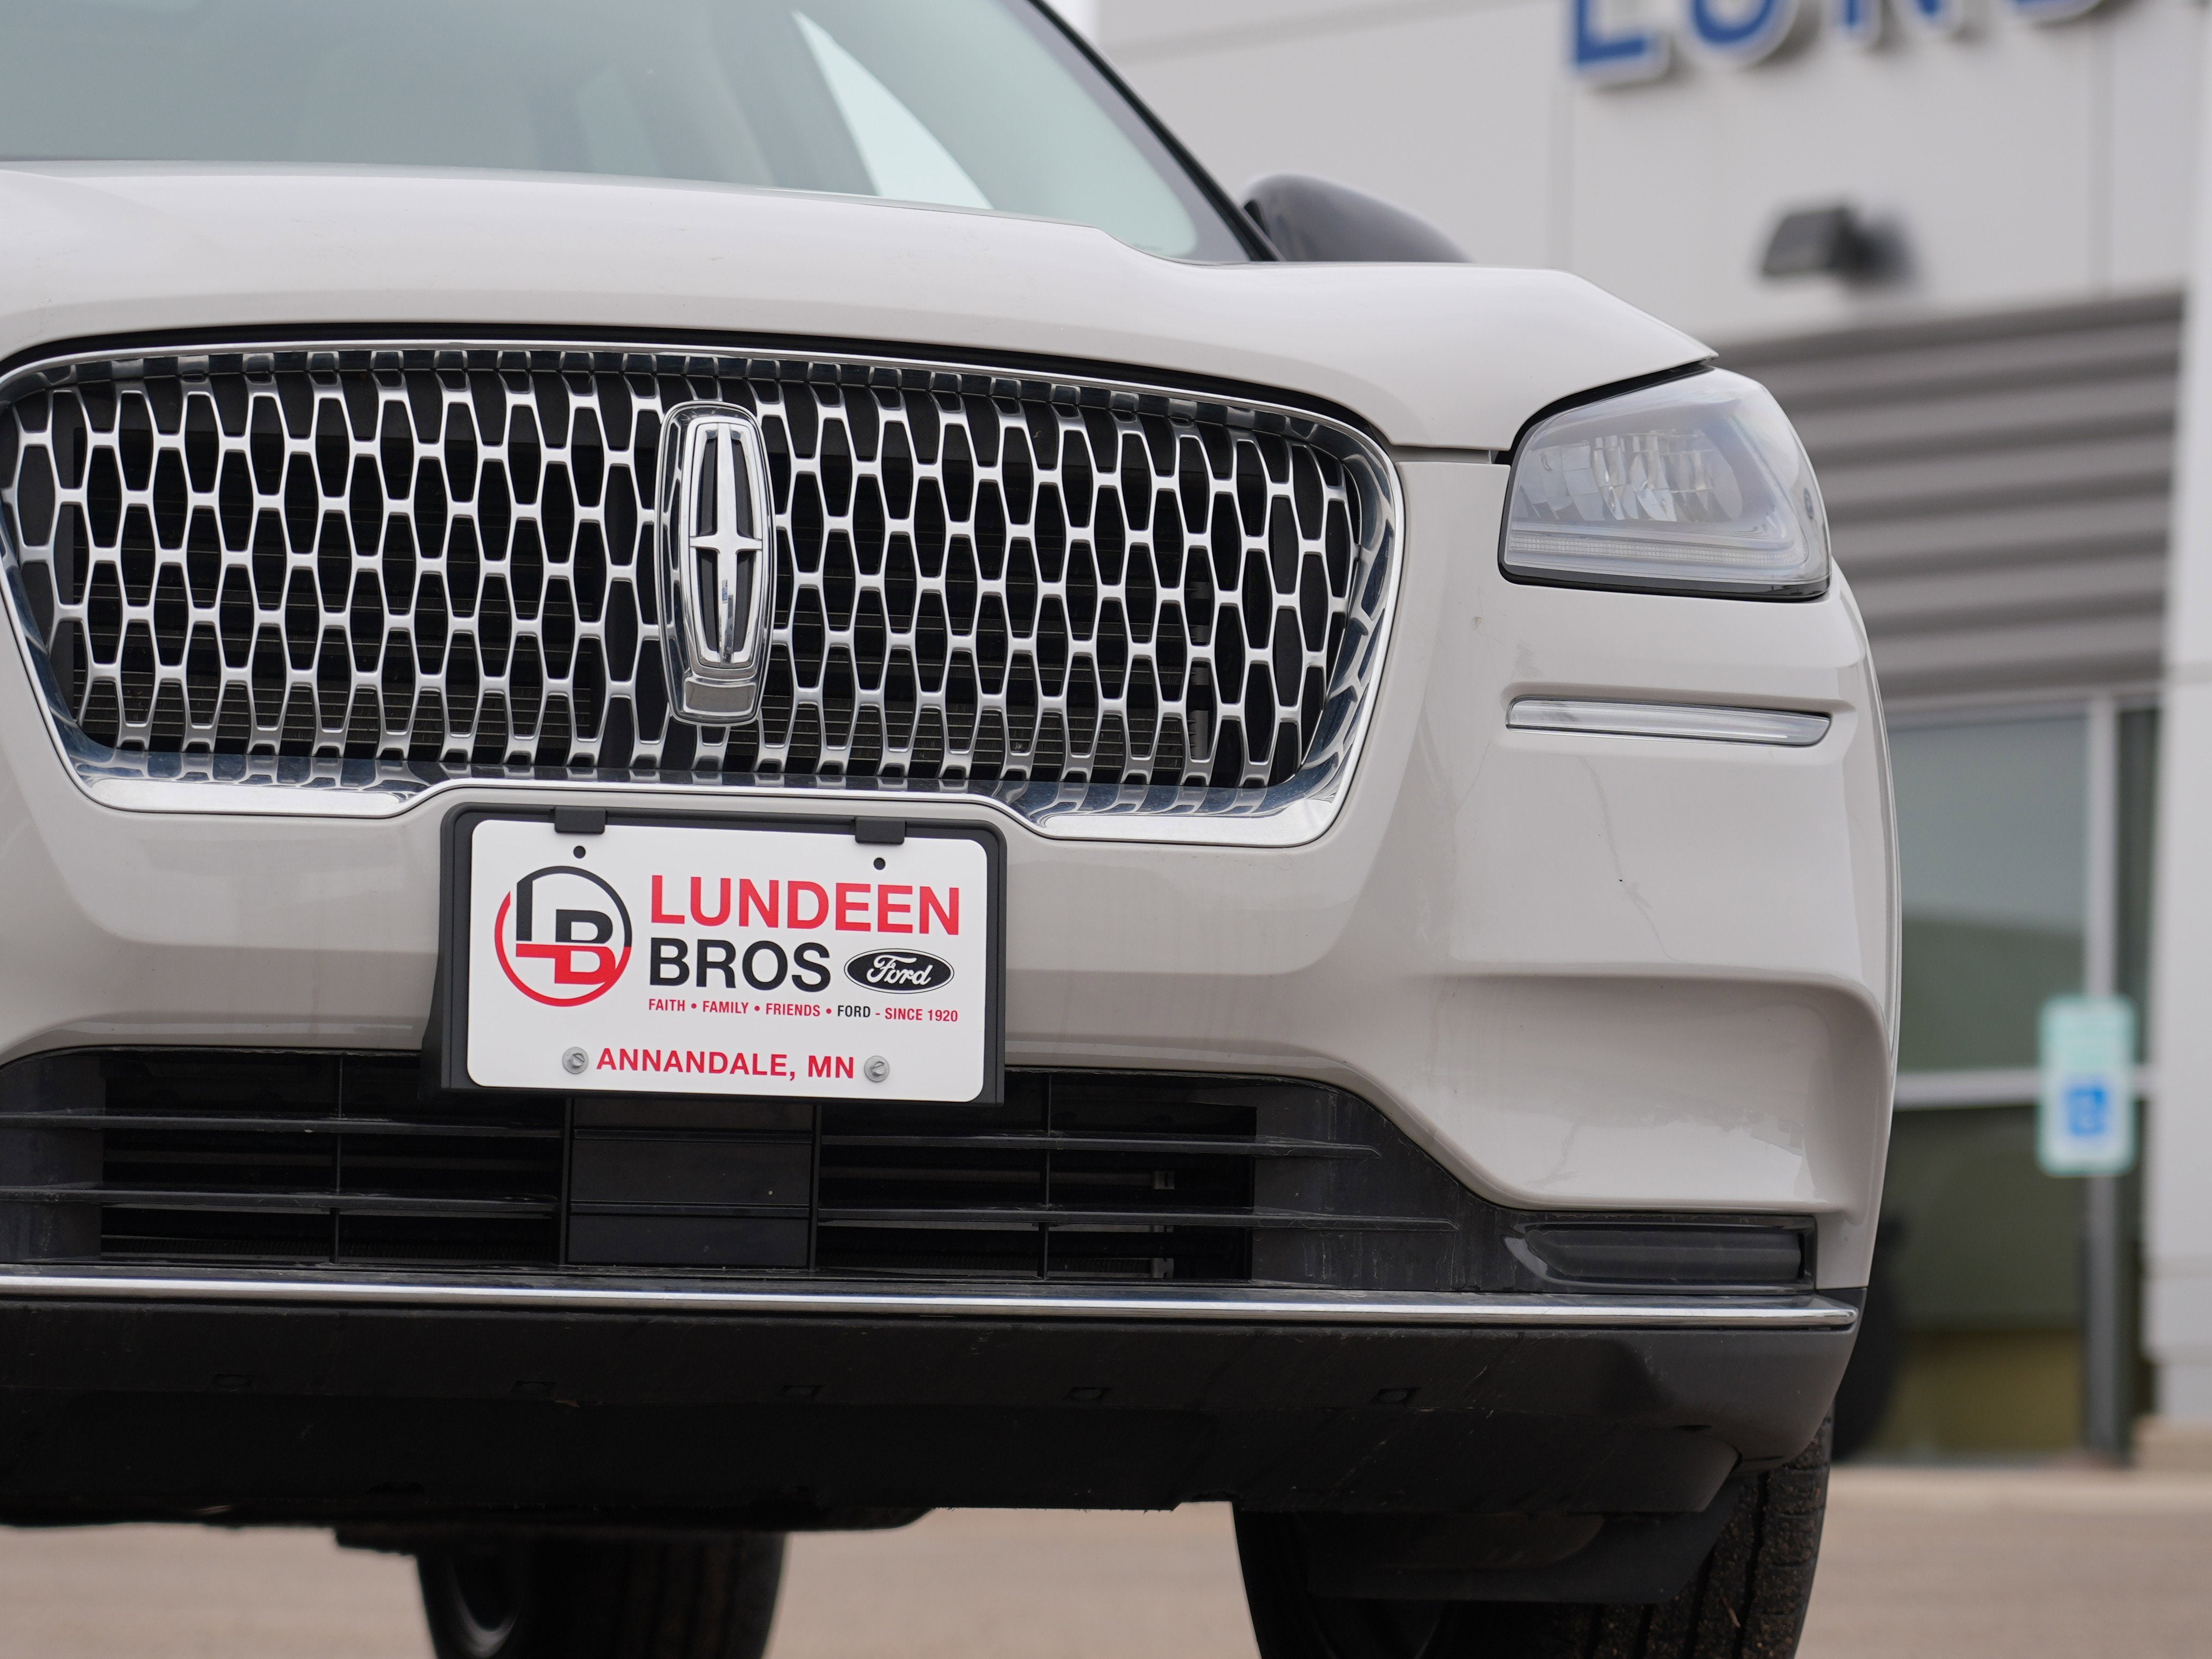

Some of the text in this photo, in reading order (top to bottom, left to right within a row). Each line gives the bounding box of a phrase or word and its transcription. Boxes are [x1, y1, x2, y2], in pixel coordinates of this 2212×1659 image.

[651, 874, 960, 936] LUNDEEN
[649, 936, 832, 993] BROS
[866, 954, 933, 986] Ford
[648, 998, 959, 1022] FAITH FAMILY FRIENDS FORD SINCE 1920
[596, 1047, 854, 1082] ANNANDALE, MN
